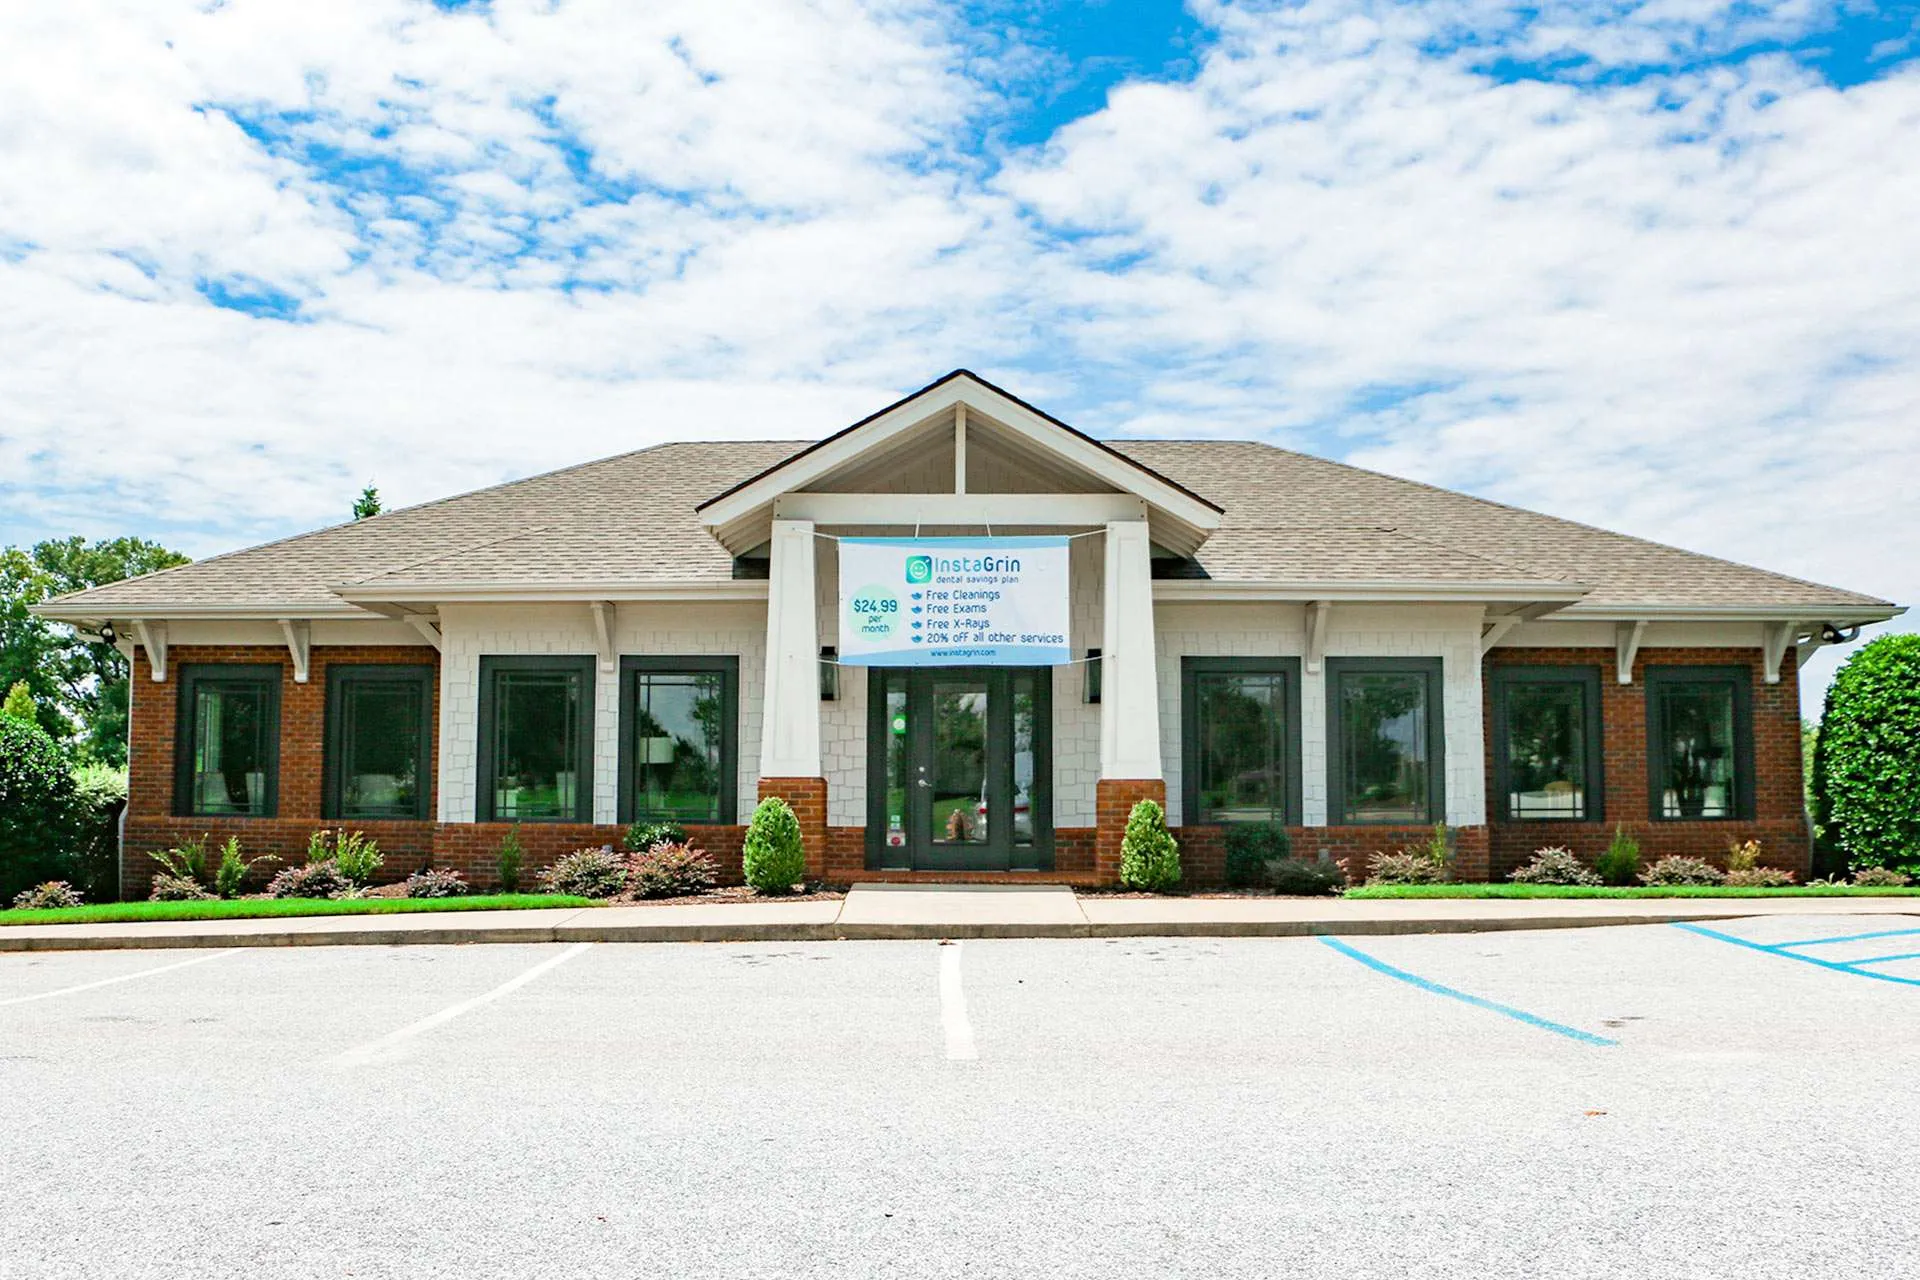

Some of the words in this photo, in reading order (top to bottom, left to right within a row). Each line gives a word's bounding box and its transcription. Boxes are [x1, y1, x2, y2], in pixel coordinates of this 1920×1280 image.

[935, 557, 1020, 572] InstaGrin
[966, 576, 998, 584] savings
[1002, 576, 1018, 584] plan
[927, 591, 948, 599] Free
[953, 591, 1000, 601] Cleanings
[854, 600, 897, 613] $24.99
[927, 605, 949, 613] Free
[954, 605, 986, 613] Exams
[862, 625, 889, 633] month
[927, 620, 949, 628] Free
[954, 619, 990, 630] X-Rays
[927, 634, 948, 643] 20%
[953, 633, 968, 642] off
[974, 633, 984, 642] all
[988, 633, 1016, 642] other
[1021, 634, 1063, 643] services
[931, 649, 996, 657] www.instagrin.com
